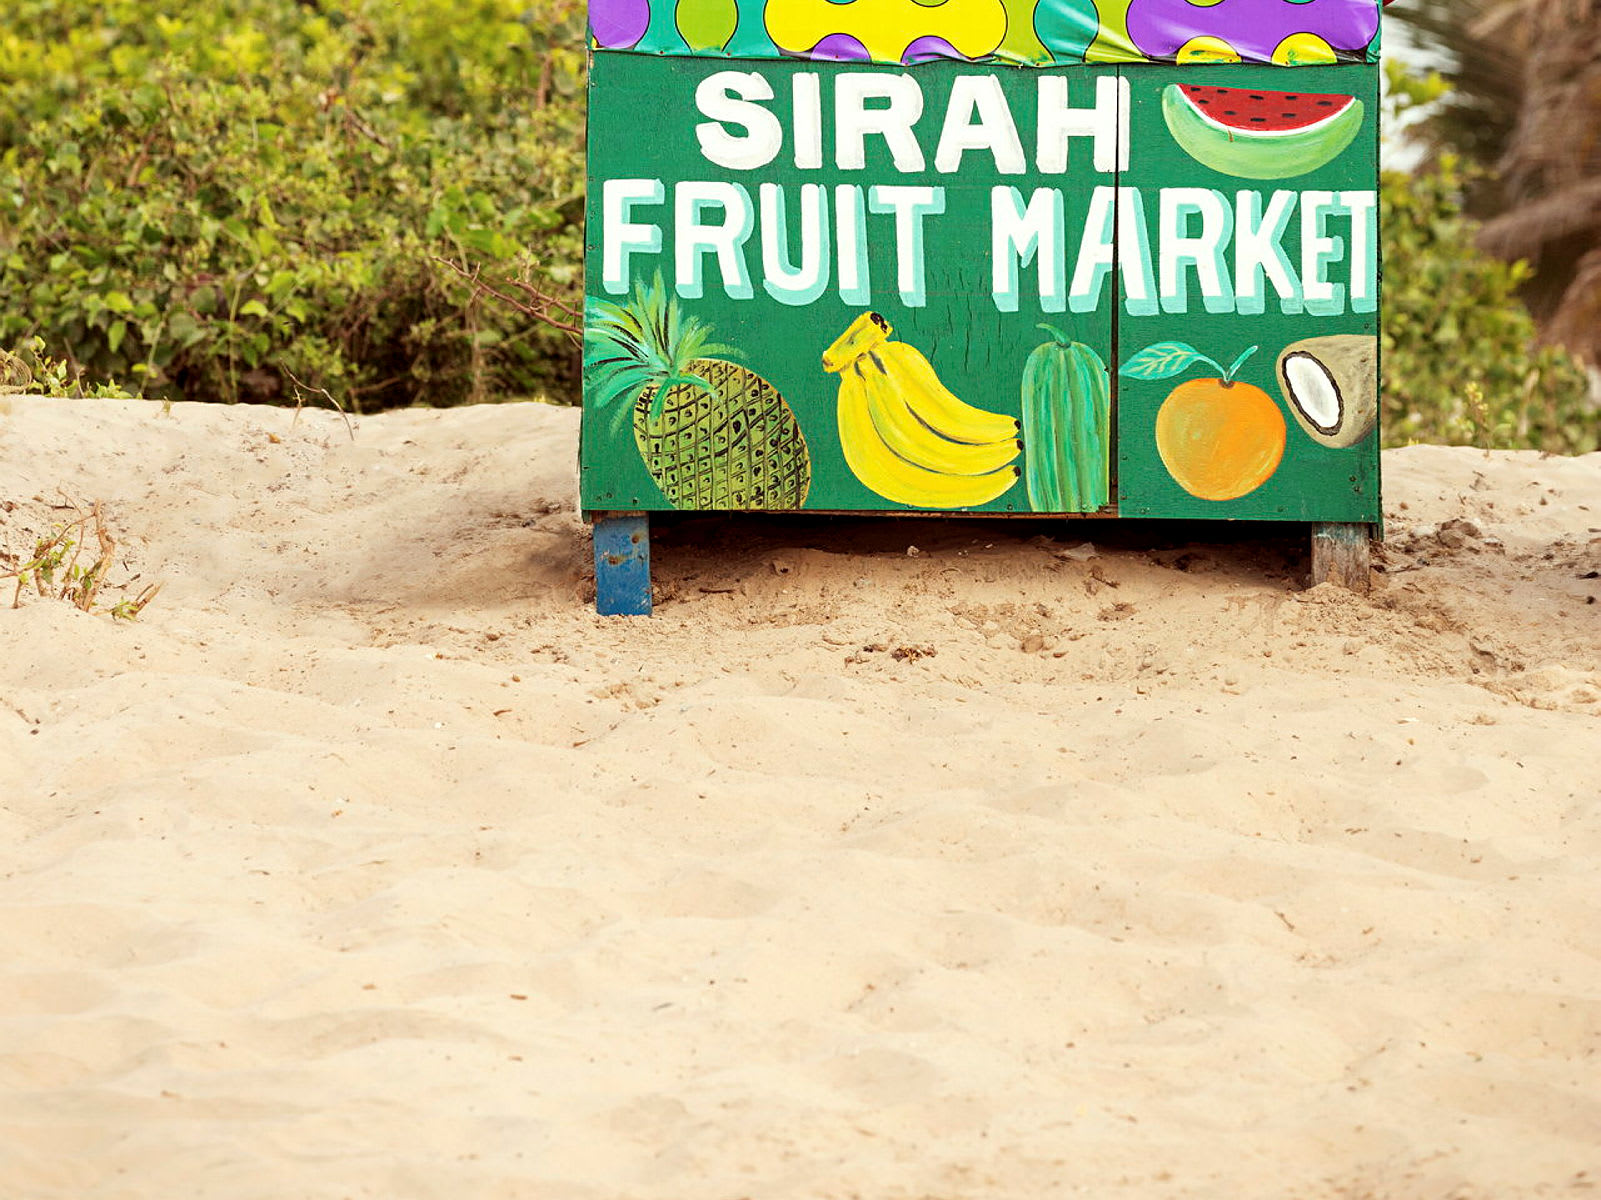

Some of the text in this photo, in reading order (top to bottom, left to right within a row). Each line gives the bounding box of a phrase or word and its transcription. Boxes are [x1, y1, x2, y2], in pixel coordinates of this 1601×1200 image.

[694, 70, 1131, 174] SIRAH
[602, 178, 1378, 317] FRUIT MARKET
